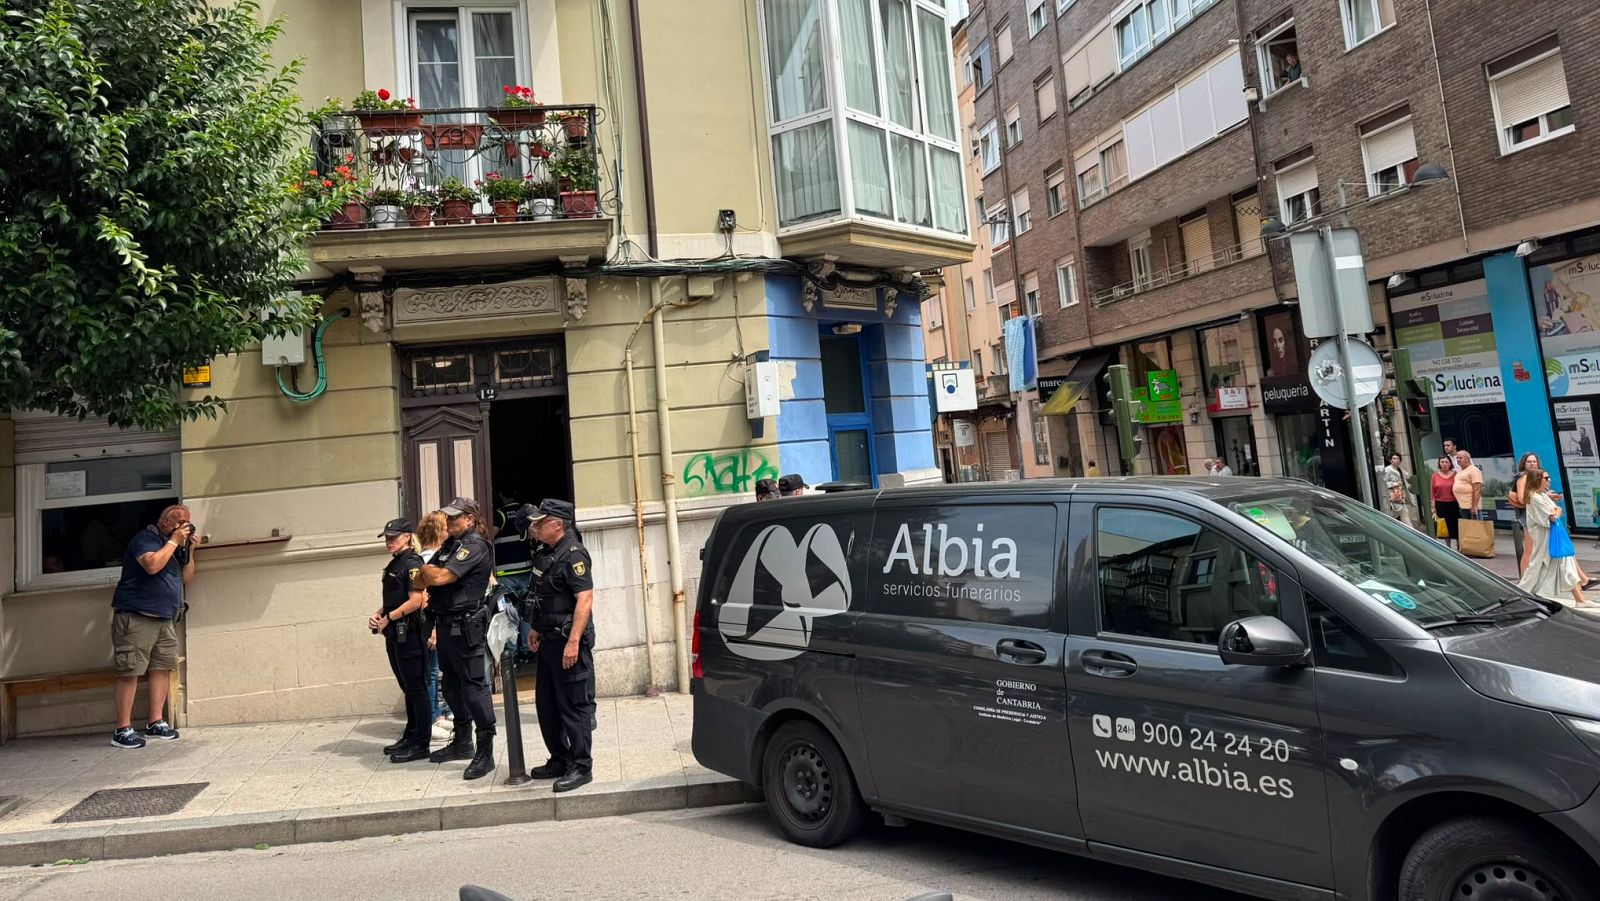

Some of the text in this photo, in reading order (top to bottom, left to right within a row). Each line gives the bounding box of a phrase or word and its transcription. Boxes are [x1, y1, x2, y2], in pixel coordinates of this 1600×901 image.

[1568, 262, 1600, 275] mSoluc
[1421, 290, 1453, 302] mSoluciona
[1039, 379, 1065, 388] marc
[481, 389, 495, 399] 12
[883, 523, 1020, 578] Albia
[883, 581, 1021, 602] servicios funerarios
[996, 679, 1037, 692] GOBIERNO
[996, 688, 1005, 696] de
[996, 696, 1041, 710] CANTABRIA
[1117, 721, 1290, 762] 24H 900 24 24 20
[1095, 749, 1294, 799] www.albia.es
